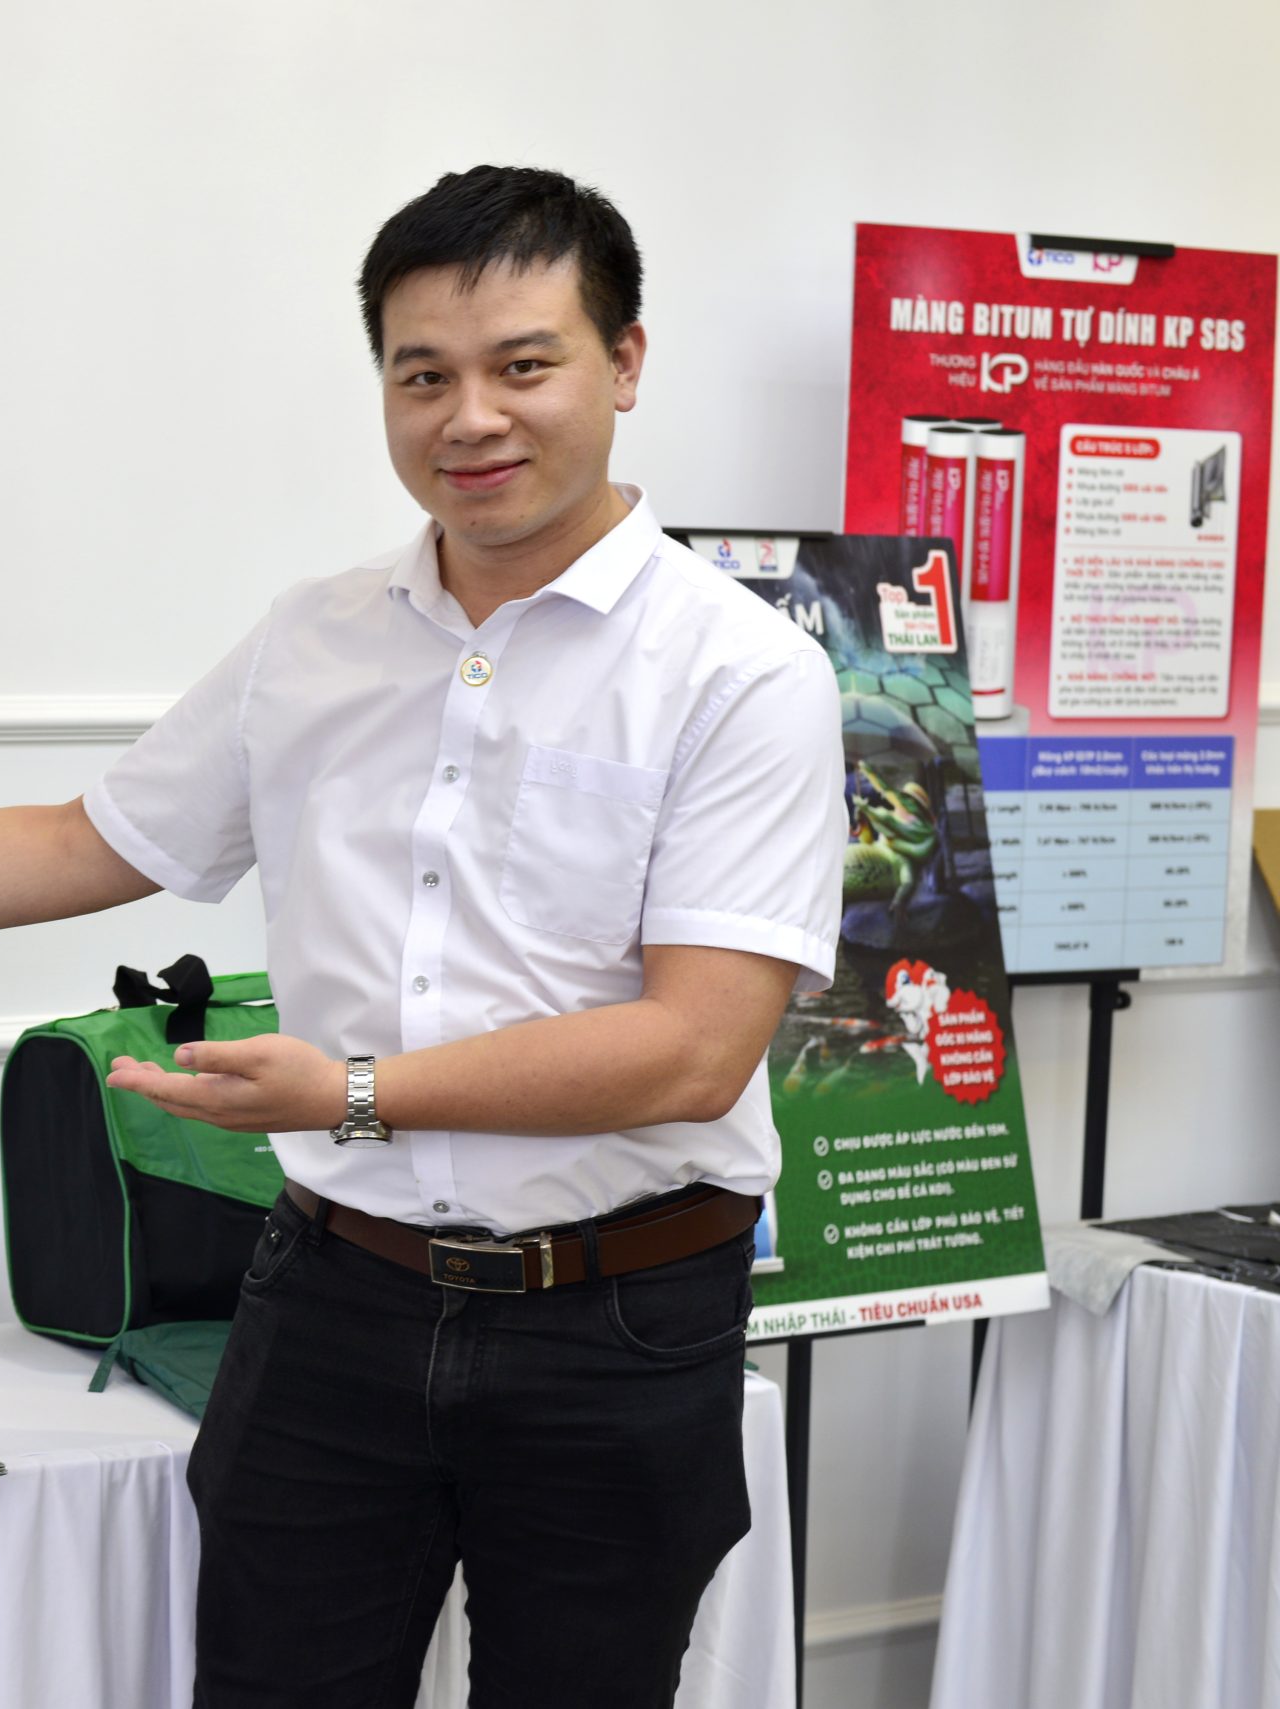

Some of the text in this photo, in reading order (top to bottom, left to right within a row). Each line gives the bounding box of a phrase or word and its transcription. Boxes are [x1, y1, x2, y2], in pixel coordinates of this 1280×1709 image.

[890, 294, 1246, 352] MÀNG BITUM TỰ DÍNH KP SBS
[980, 351, 1030, 394] KP
[917, 556, 954, 646] 1
[940, 1050, 973, 1067] KHÔNG
[833, 1137, 861, 1152] CHỊU
[863, 1133, 894, 1149] ĐƯỢC
[895, 1129, 910, 1146] ÁP
[933, 1125, 963, 1142] NƯỚC
[840, 1189, 872, 1207] DỤNG
[872, 1187, 896, 1202] CHO
[844, 1221, 884, 1239] KHÔNG
[847, 1242, 875, 1260] KIỆM
[442, 1273, 477, 1285] TOYOTA
[746, 1319, 760, 1336] M
[763, 1310, 808, 1337] NHẬP
[809, 1308, 847, 1329] THÁI
[858, 1301, 894, 1323] TIÊU
[896, 1291, 950, 1319] CHUẨN
[952, 1293, 984, 1311] USA
